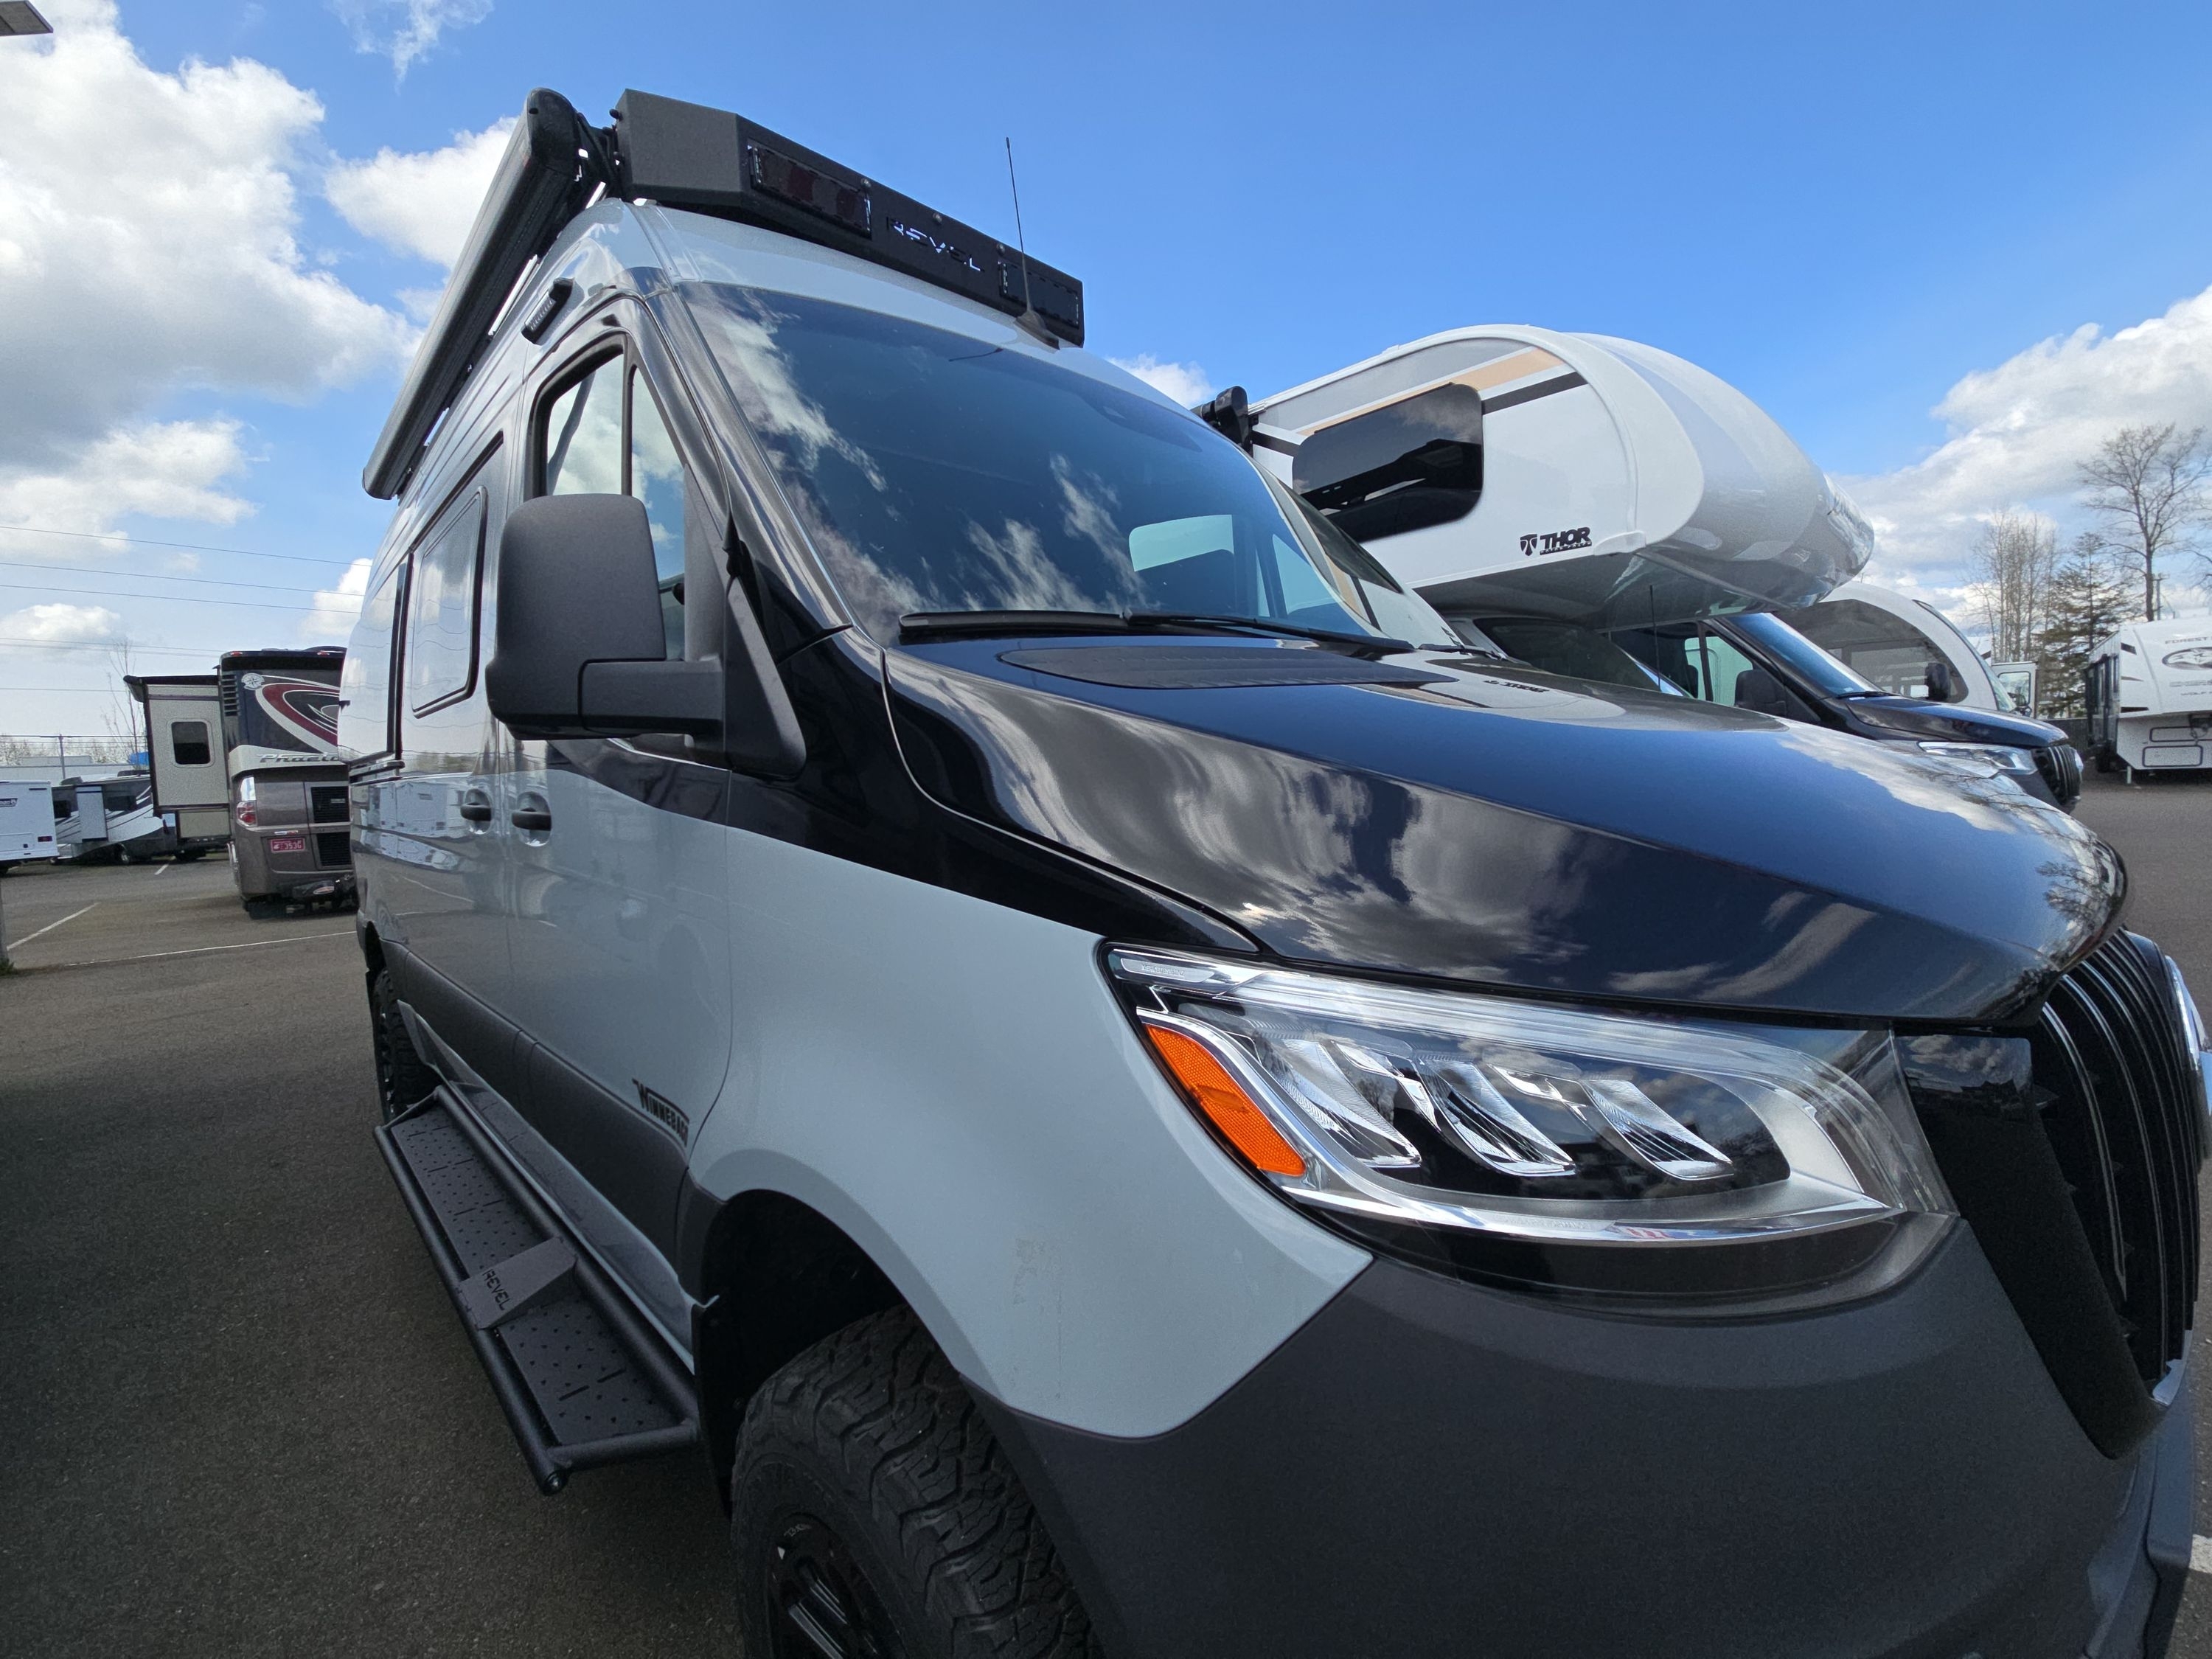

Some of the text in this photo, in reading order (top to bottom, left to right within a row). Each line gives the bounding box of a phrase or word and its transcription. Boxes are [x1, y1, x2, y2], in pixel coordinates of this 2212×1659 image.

[1540, 526, 1591, 549] THOR
[257, 752, 339, 763] Phaeto
[482, 1268, 512, 1311] REVEL
